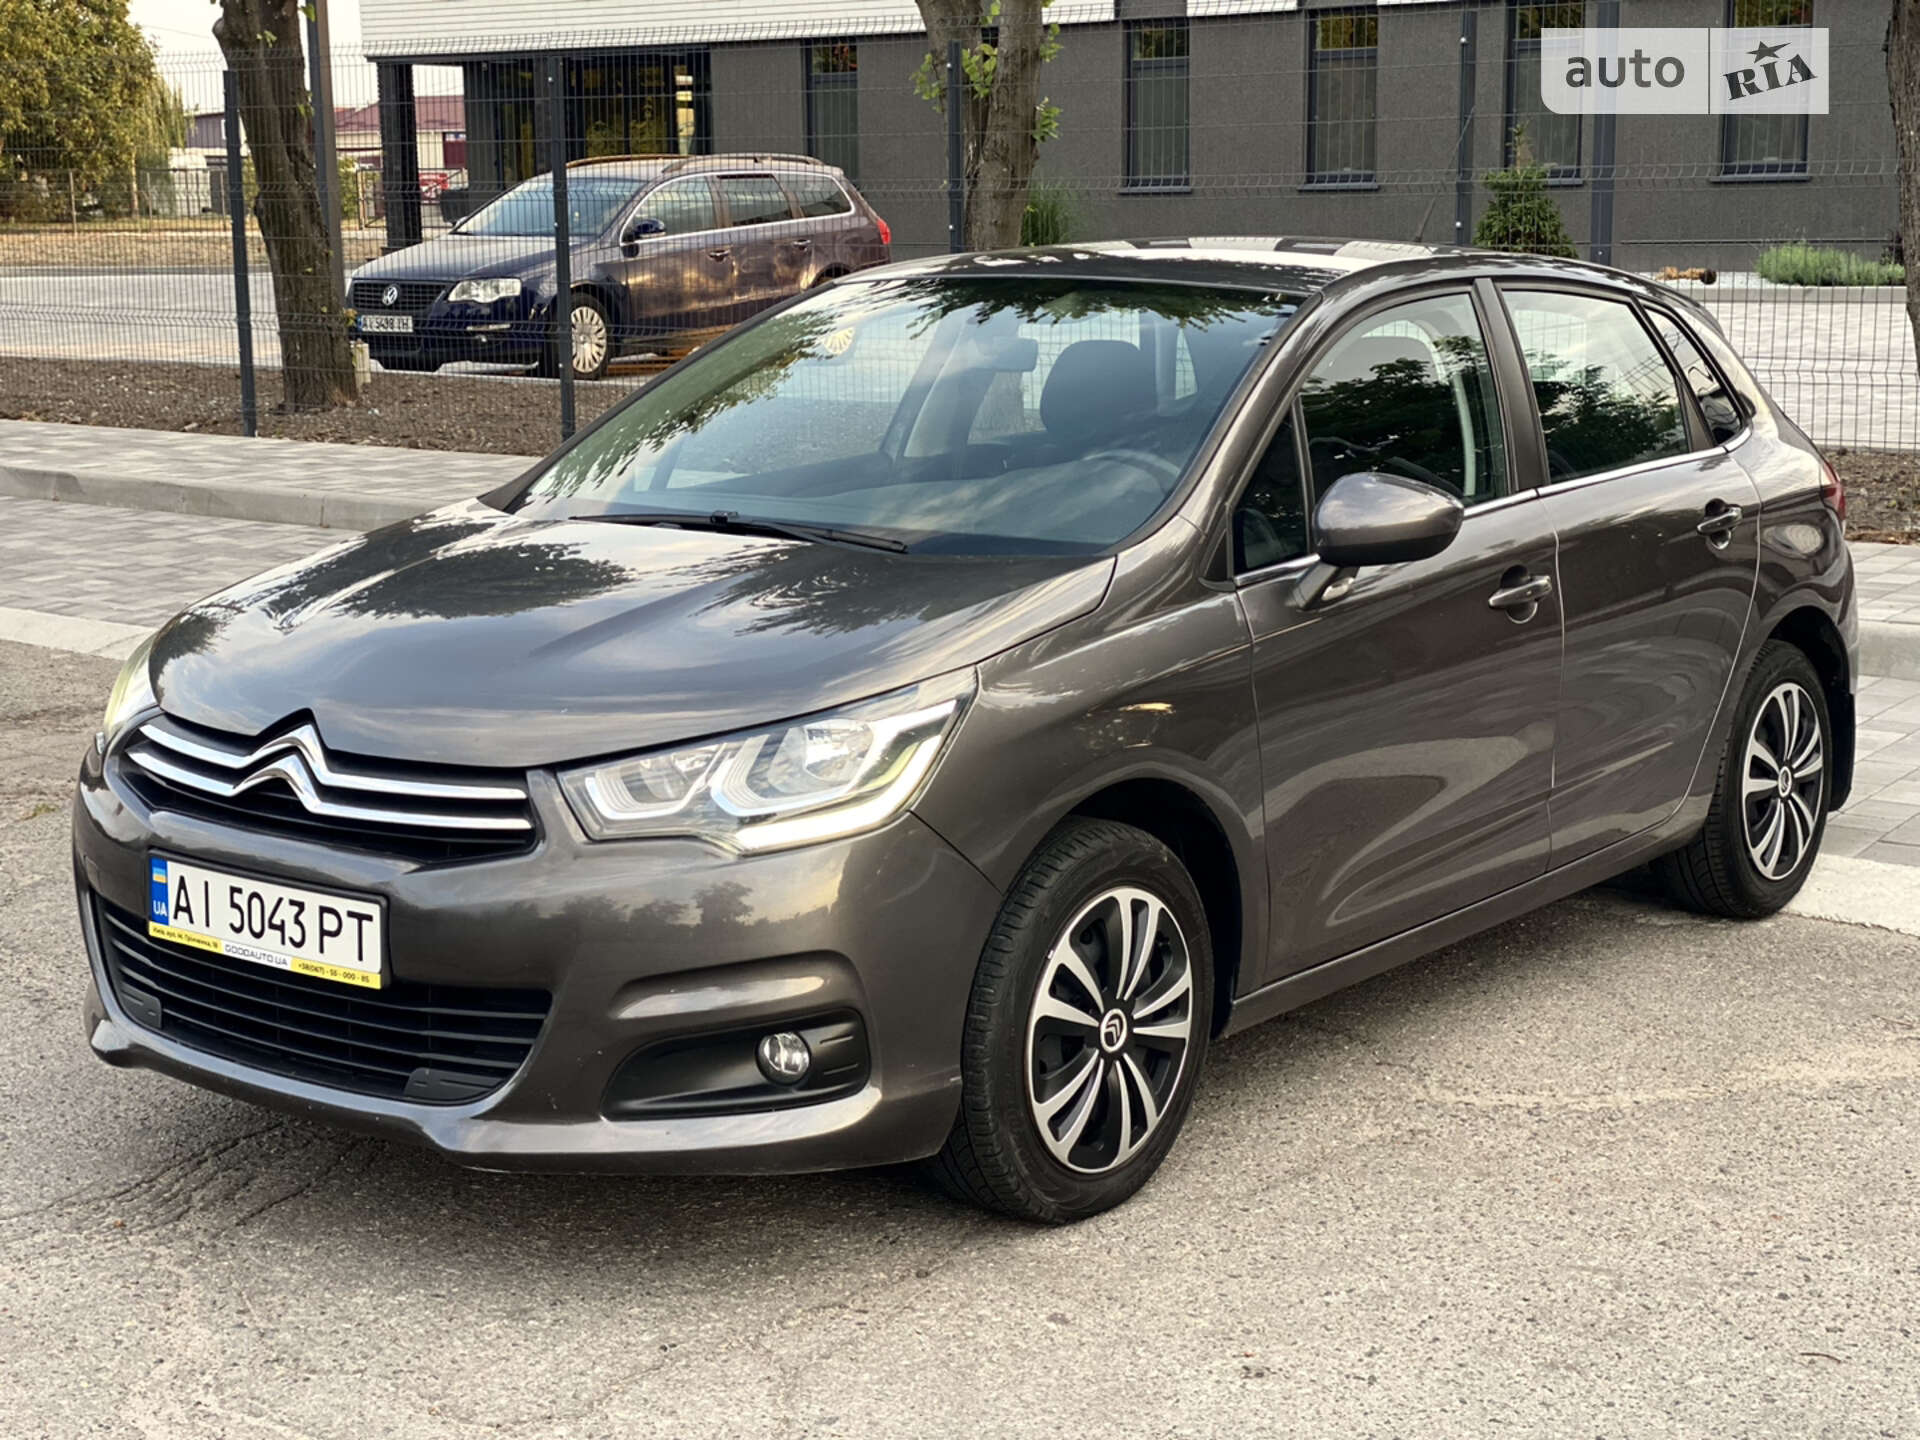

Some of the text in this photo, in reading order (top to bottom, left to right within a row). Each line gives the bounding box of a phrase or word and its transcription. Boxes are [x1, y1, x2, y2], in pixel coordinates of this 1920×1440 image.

[152, 900, 168, 917] UA
[173, 875, 374, 962] AI 5043 PT
